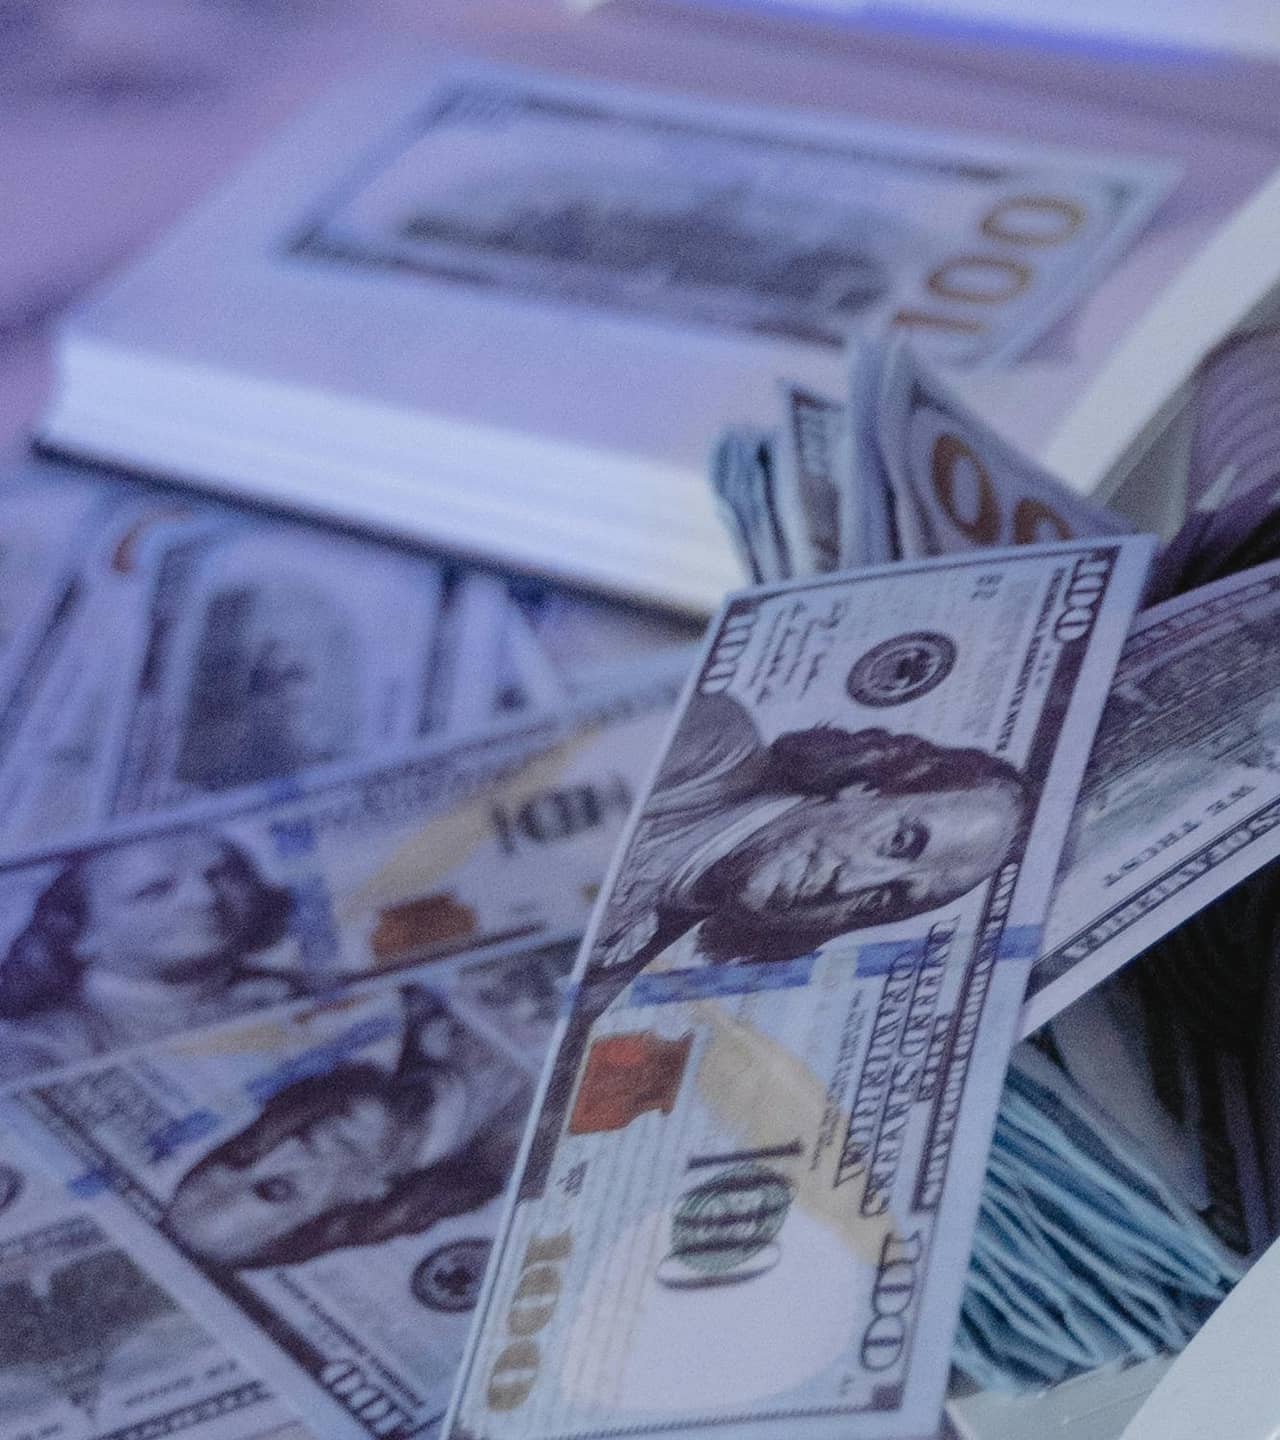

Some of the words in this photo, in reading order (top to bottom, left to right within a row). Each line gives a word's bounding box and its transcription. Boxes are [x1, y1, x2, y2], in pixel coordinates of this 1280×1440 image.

[890, 193, 1088, 336] 100
[697, 613, 760, 694] 100
[1052, 559, 1108, 643] 100
[1099, 813, 1203, 888] TRUST
[1203, 780, 1256, 819] WE
[1205, 823, 1253, 862] OF
[1060, 849, 1212, 961] AMERICA
[897, 916, 958, 1057] UNITED
[833, 1002, 903, 1188] AMERICA
[859, 1061, 920, 1216] STATES
[655, 1139, 804, 1288] 100
[484, 1232, 574, 1412] 100
[858, 1232, 924, 1371] 100
[316, 1355, 412, 1440] 100
